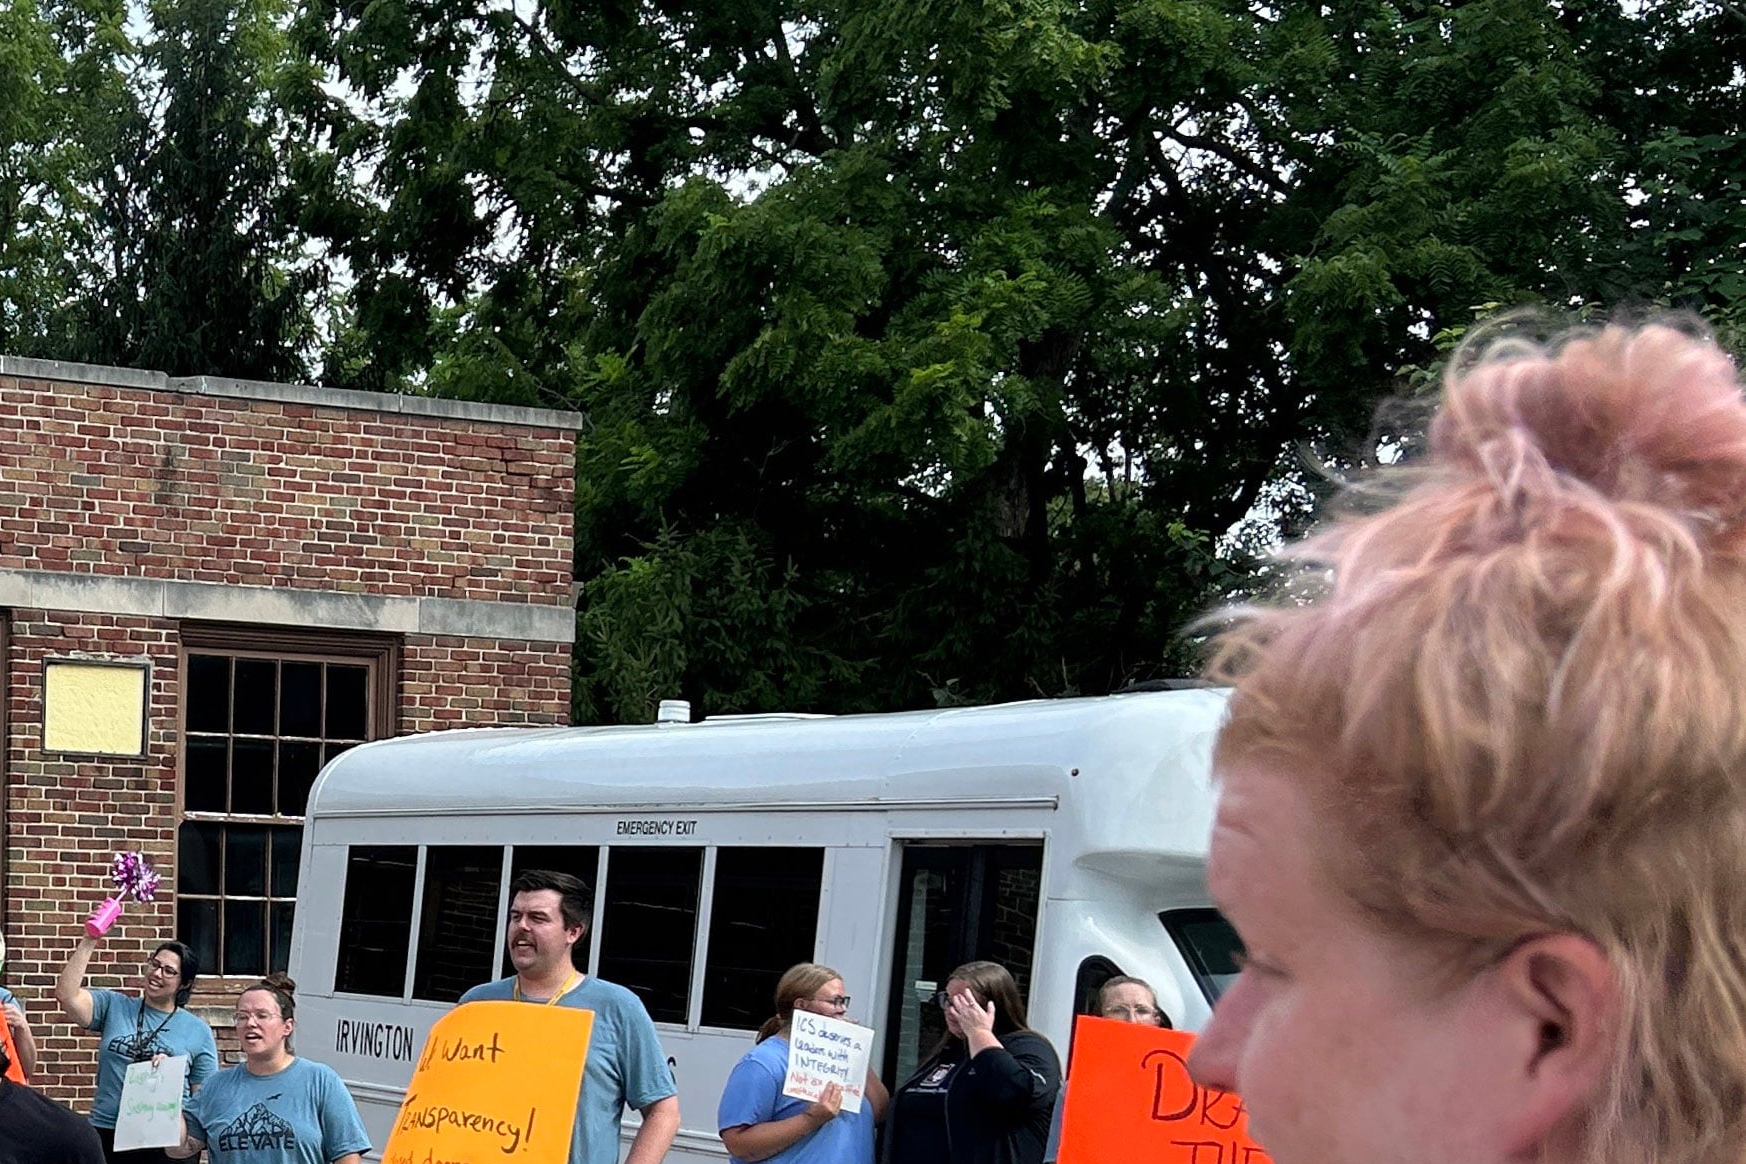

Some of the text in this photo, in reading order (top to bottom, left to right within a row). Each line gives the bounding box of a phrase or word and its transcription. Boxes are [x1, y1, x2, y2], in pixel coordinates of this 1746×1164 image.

[617, 820, 697, 835] EMERGENCY EXIT
[336, 1019, 414, 1062] IRVINGTON
[441, 1032, 505, 1064] Want
[796, 1016, 816, 1035] ICS
[854, 1042, 862, 1051] a
[795, 1053, 849, 1082] INTEGRITY
[219, 1133, 295, 1152] ELEVATE
